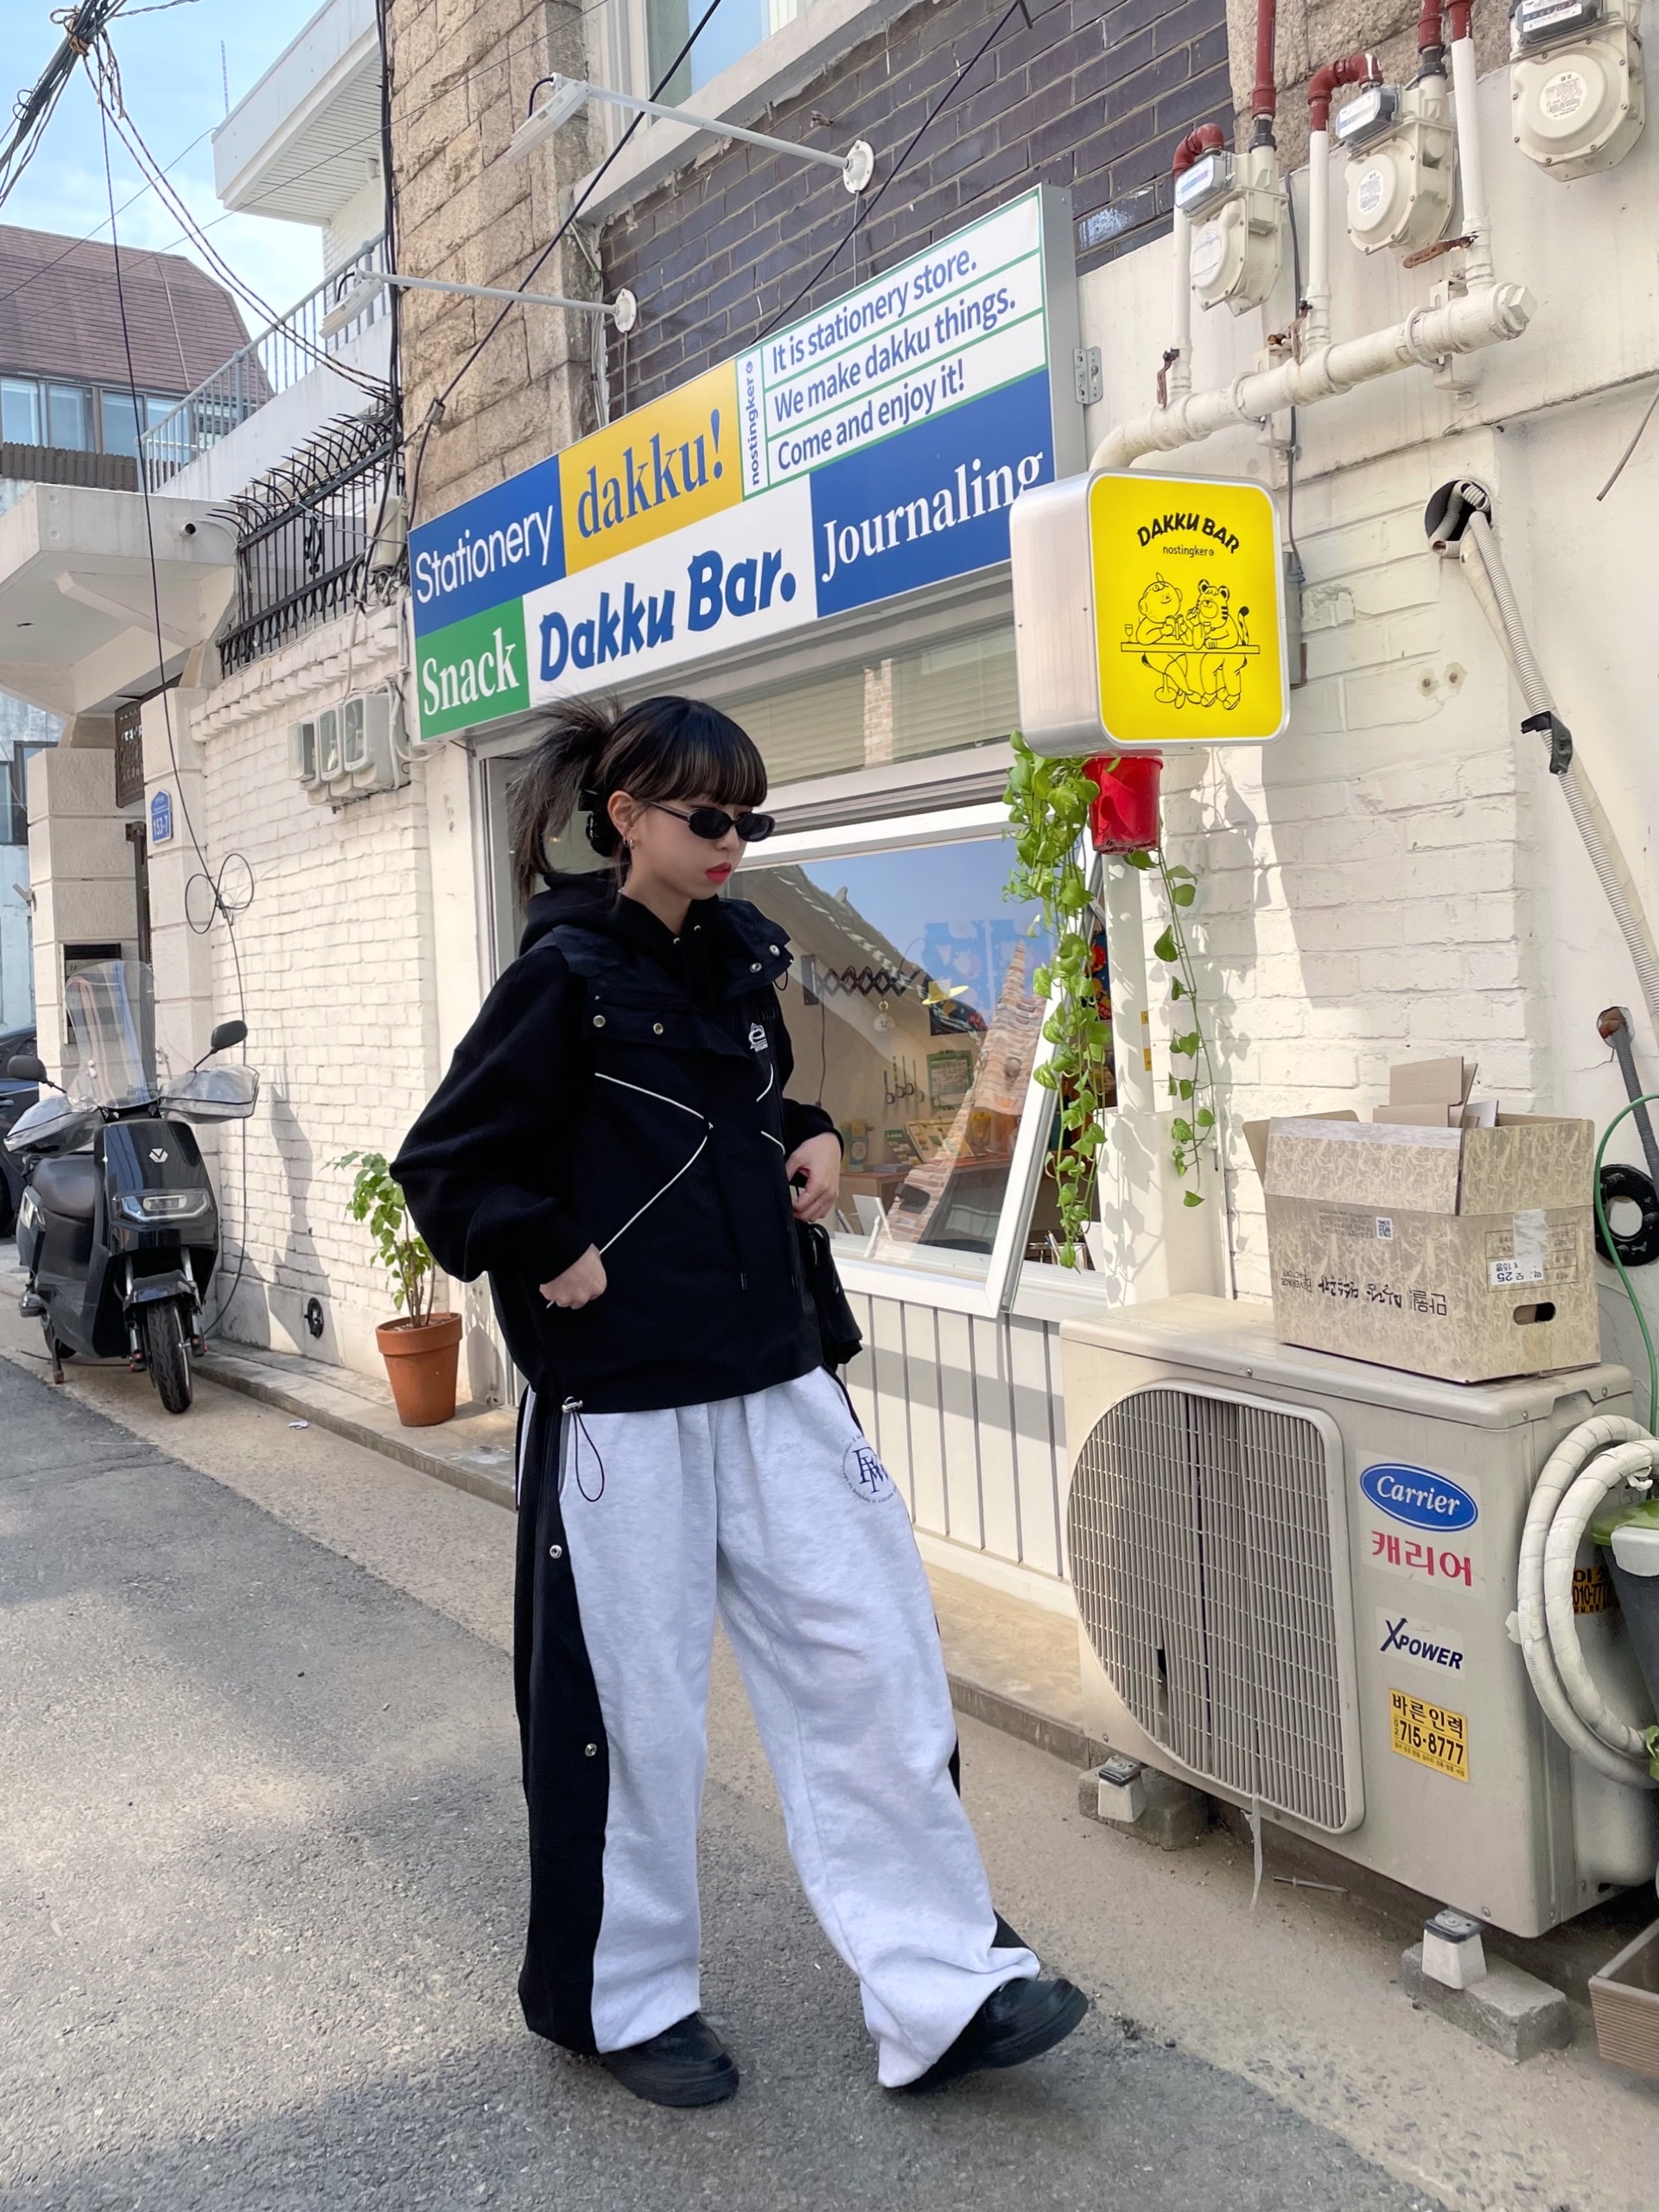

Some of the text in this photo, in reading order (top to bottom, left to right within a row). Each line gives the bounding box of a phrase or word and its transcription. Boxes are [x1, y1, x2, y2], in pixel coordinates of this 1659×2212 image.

[772, 250, 977, 374] It is stationery store.
[774, 288, 1016, 422] We make dakku things.
[778, 358, 965, 470] Come and enjoy it!
[577, 409, 724, 538] dakku!
[821, 452, 1044, 583] Journaling
[415, 503, 554, 604] Stationery
[1137, 512, 1240, 554] DAKKU BAR
[423, 626, 519, 716] Snack
[539, 549, 798, 682] Dakku Bar.
[1376, 1475, 1461, 1516] Carrier
[1371, 1530, 1472, 1587] 캐리어
